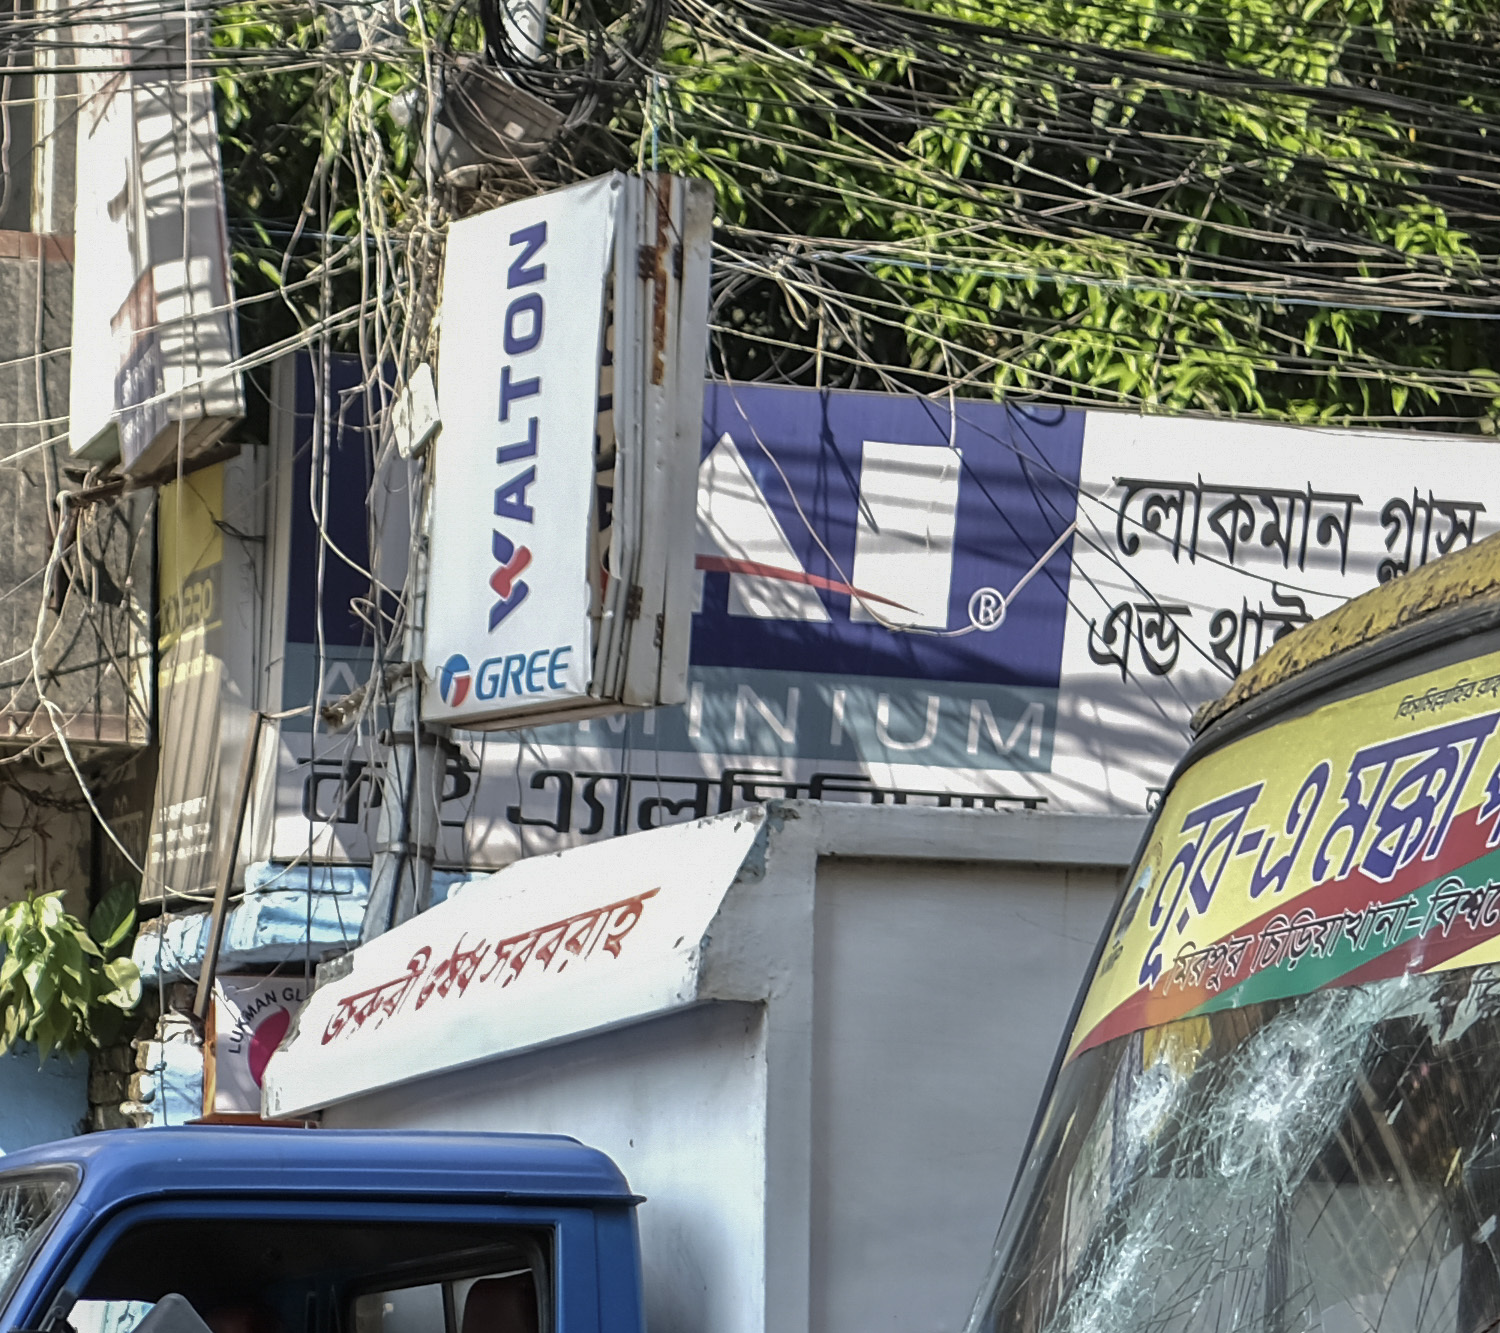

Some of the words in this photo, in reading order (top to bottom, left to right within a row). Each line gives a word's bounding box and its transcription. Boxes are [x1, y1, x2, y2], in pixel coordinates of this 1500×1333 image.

[488, 220, 549, 633] WALTON
[1113, 473, 1363, 576] লোকমান
[476, 645, 572, 701] GREE
[1310, 711, 1500, 883] মক্কা
[228, 989, 278, 1054] LUKMAN
